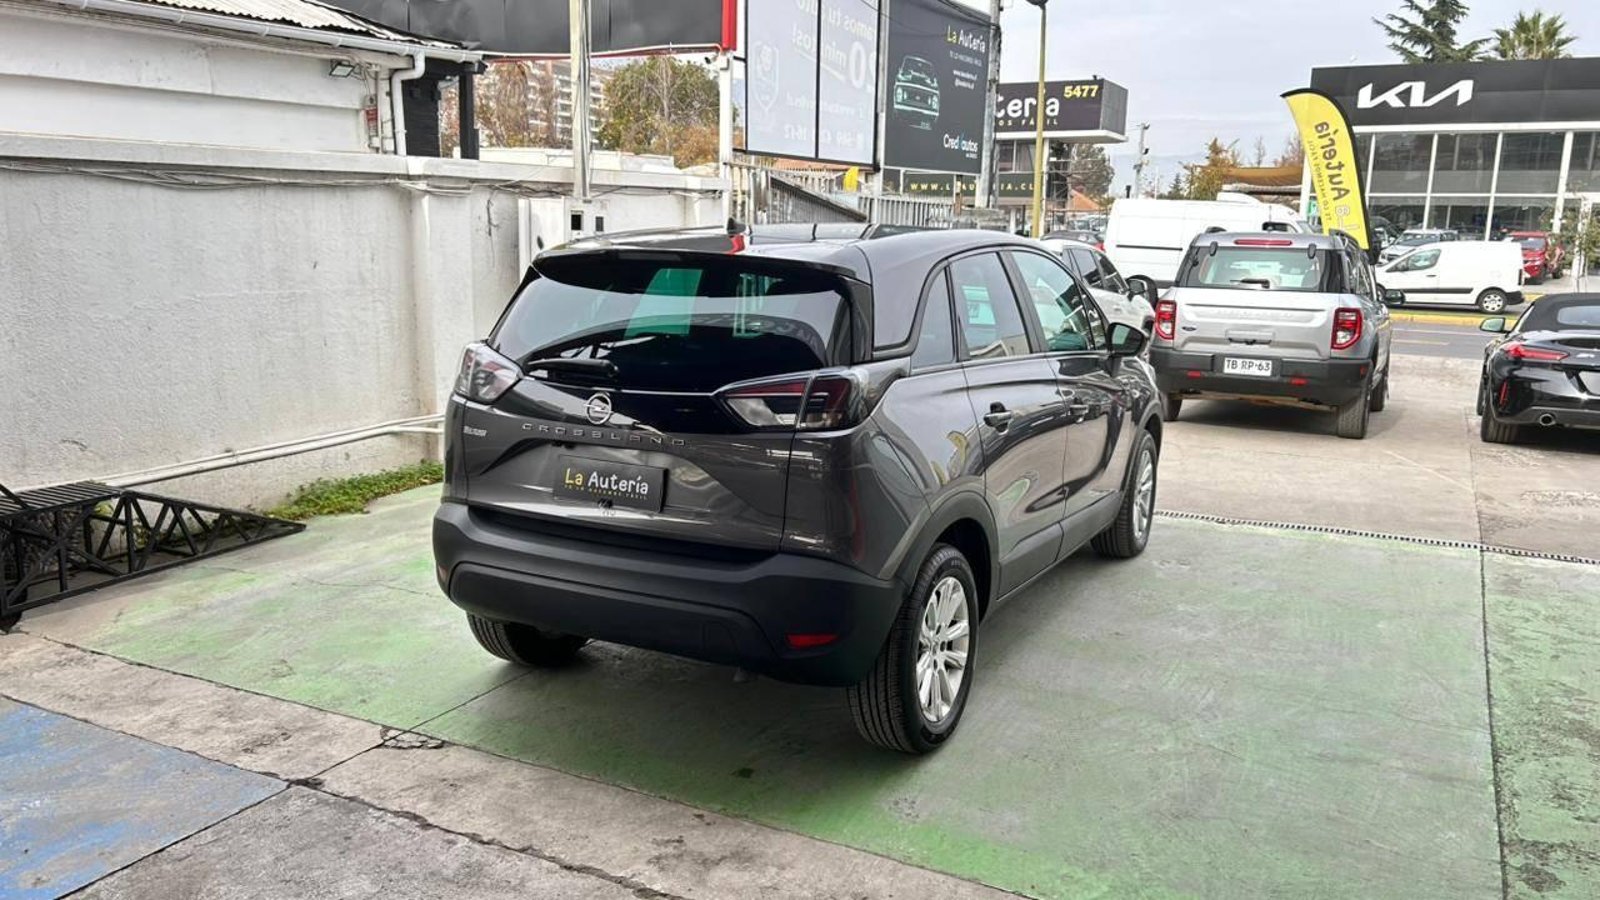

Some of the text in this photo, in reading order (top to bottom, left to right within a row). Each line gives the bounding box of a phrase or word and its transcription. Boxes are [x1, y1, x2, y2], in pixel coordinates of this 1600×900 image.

[1064, 85, 1099, 99] 5477
[1357, 80, 1474, 108] KIA
[522, 423, 685, 446] CROSSLAND
[565, 467, 649, 495] La Autería
